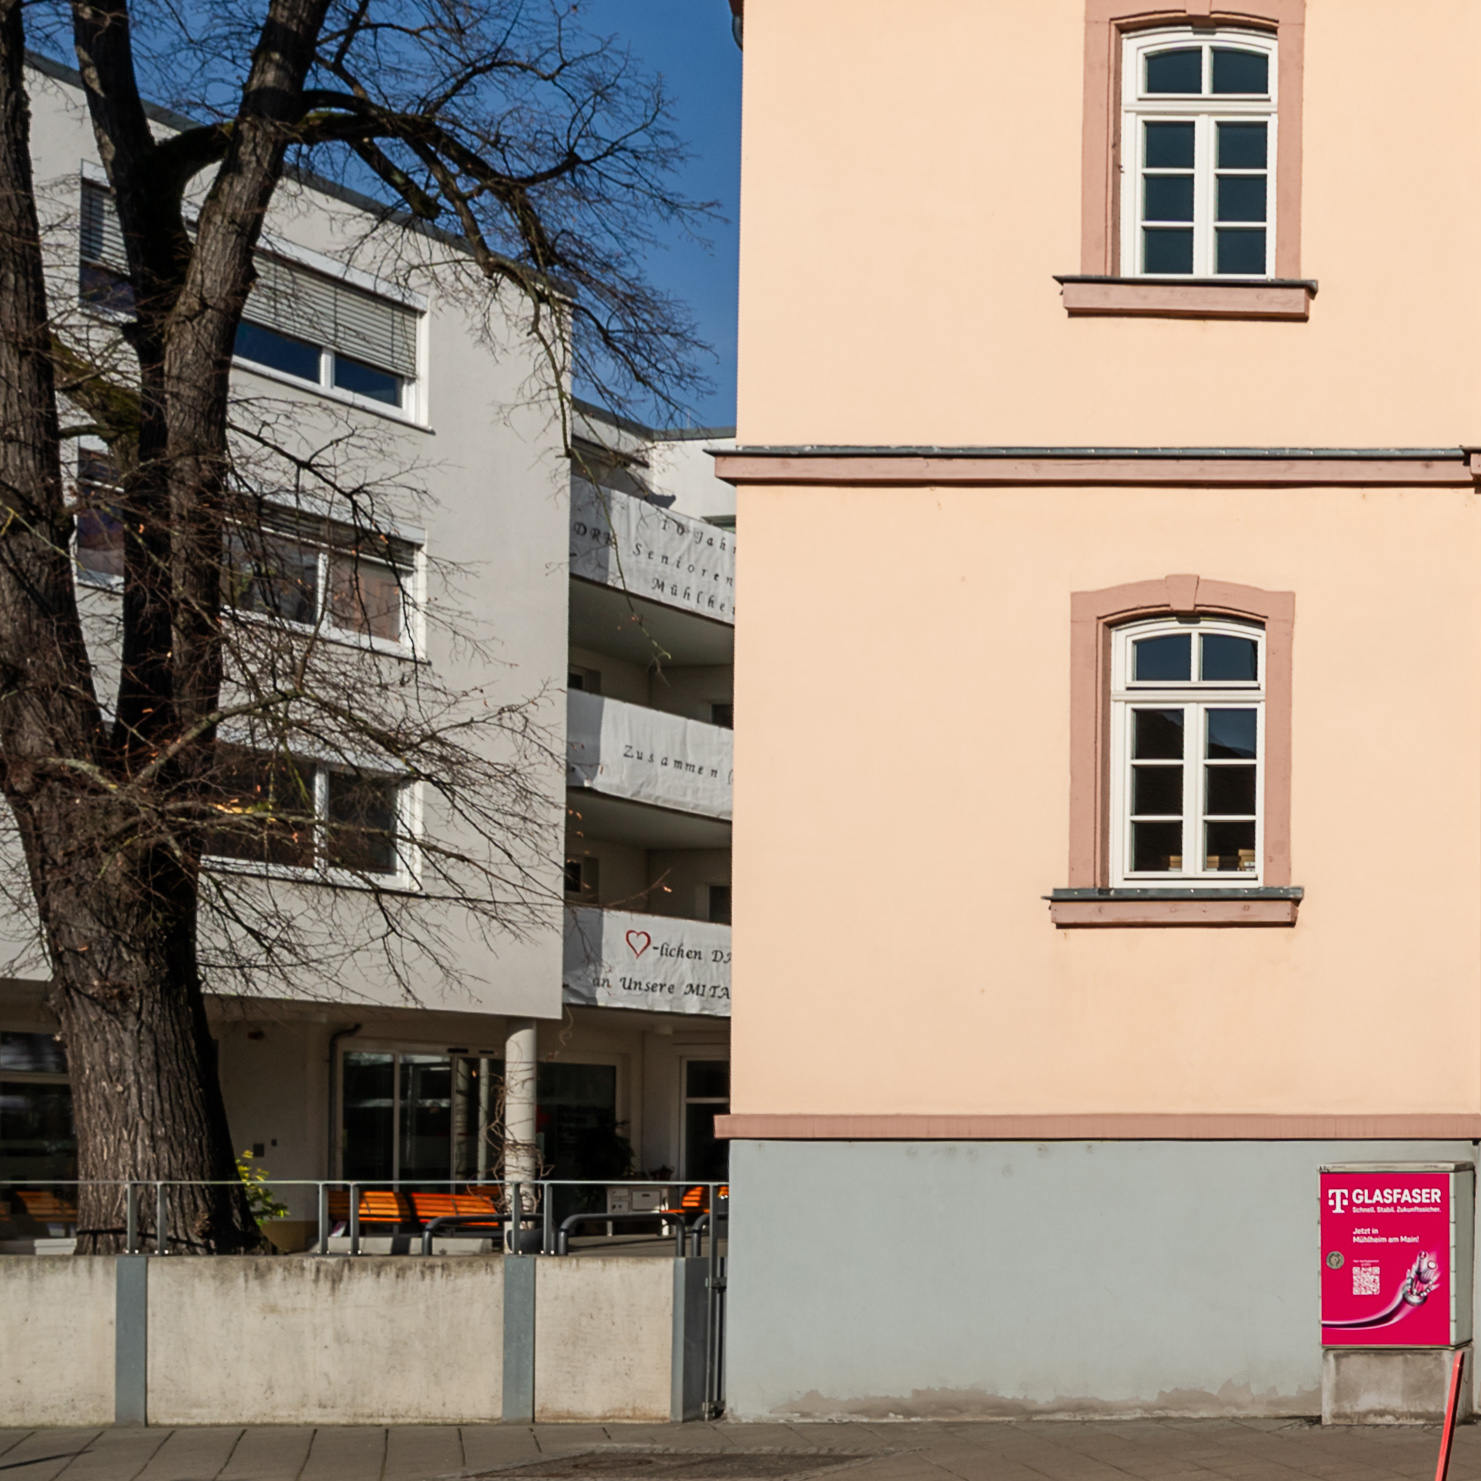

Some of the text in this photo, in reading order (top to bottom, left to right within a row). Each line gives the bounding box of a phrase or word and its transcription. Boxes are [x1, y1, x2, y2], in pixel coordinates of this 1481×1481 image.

[622, 744, 718, 778] Zusammen
[619, 976, 675, 995] Unsere
[1351, 1188, 1442, 1204] GLASFASER
[1352, 1227, 1379, 1235] Jetzt in
